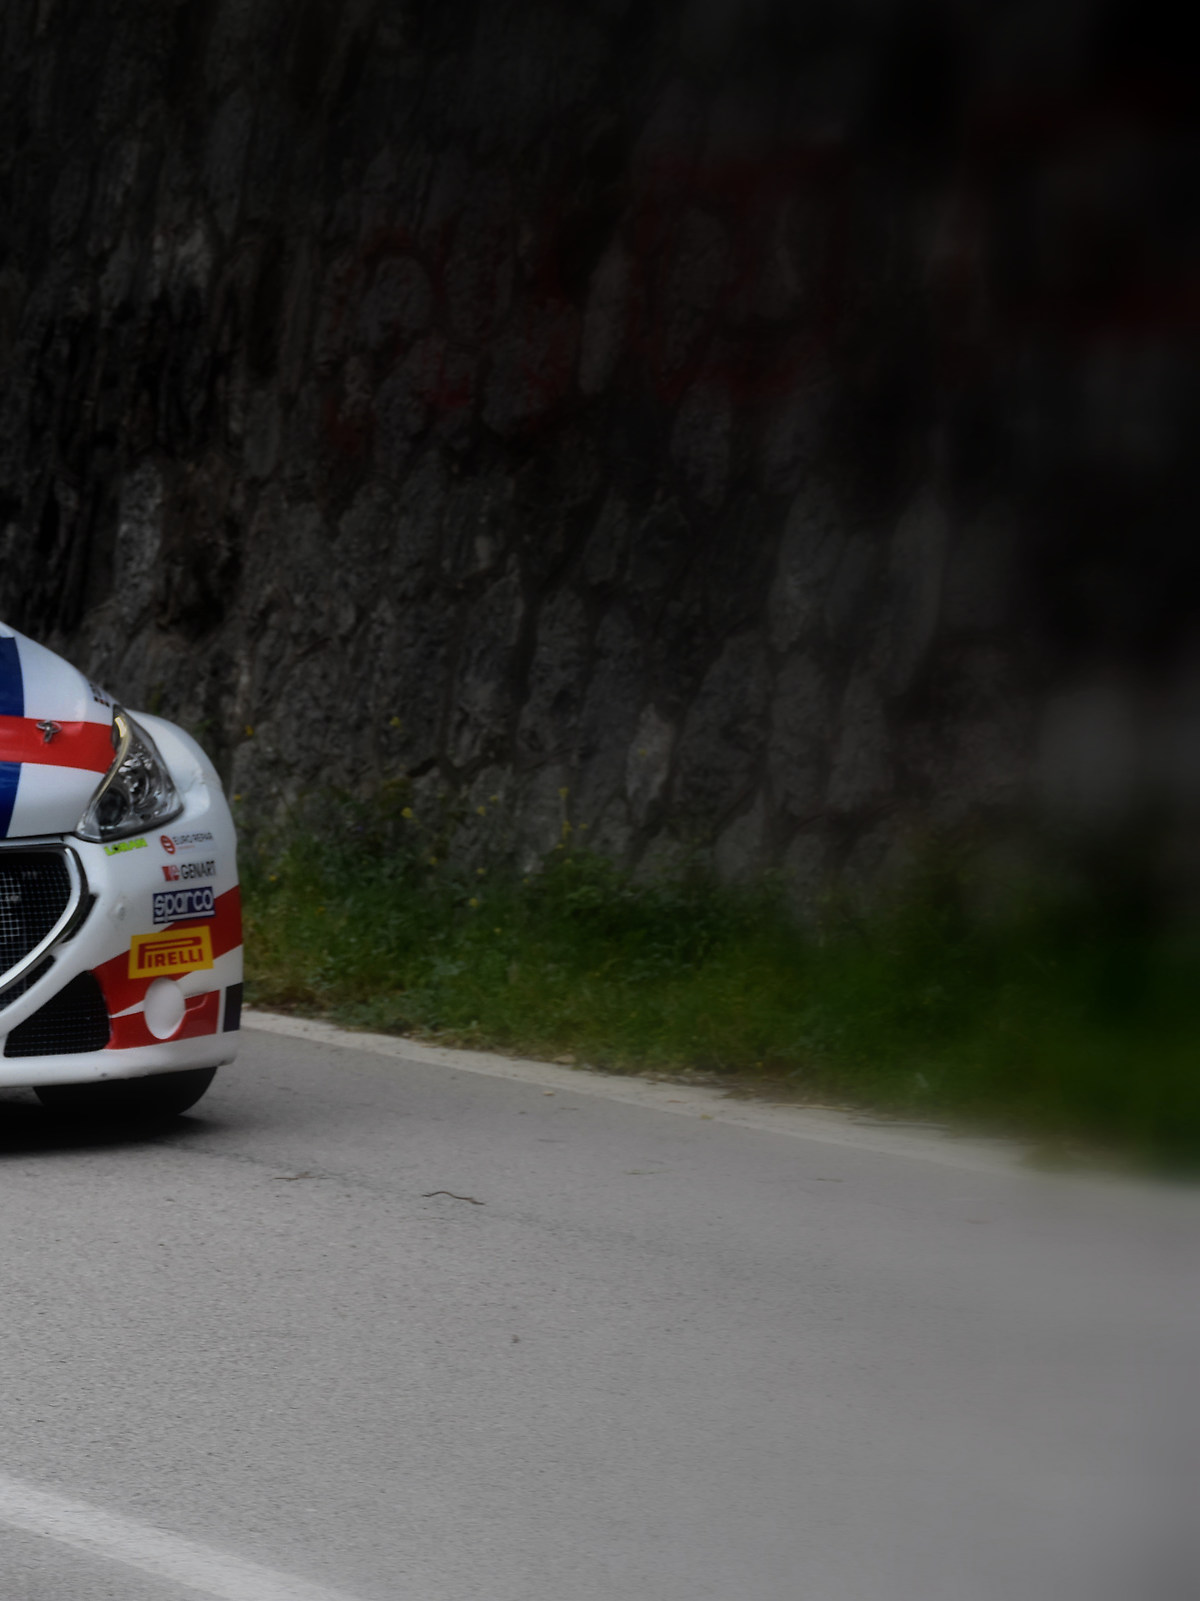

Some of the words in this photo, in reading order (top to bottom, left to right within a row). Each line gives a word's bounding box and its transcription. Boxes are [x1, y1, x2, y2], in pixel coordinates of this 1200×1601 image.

[180, 860, 216, 880] GENART
[154, 890, 214, 922] sparco
[137, 936, 204, 969] PIRELLI
